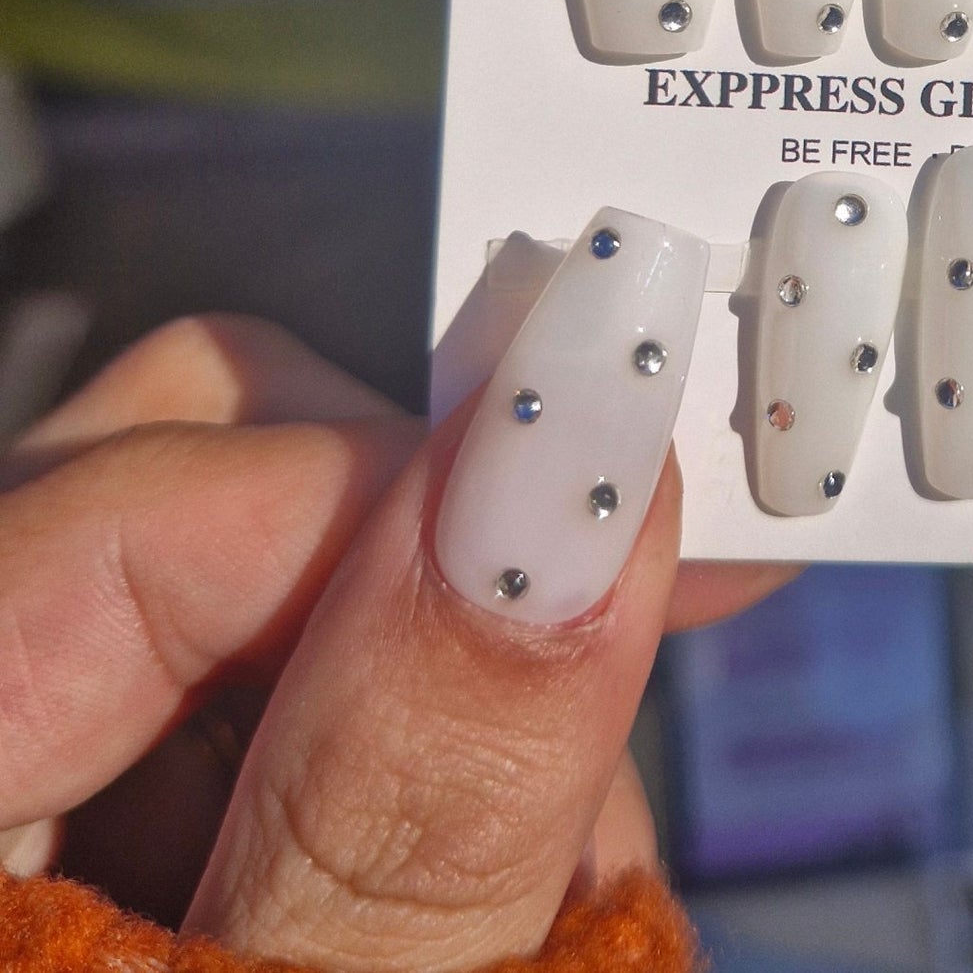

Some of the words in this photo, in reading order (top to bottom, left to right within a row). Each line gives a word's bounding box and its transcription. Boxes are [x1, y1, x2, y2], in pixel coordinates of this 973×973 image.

[643, 68, 906, 115] EXPPRESS
[781, 138, 821, 164] BE
[831, 139, 912, 167] FREE
